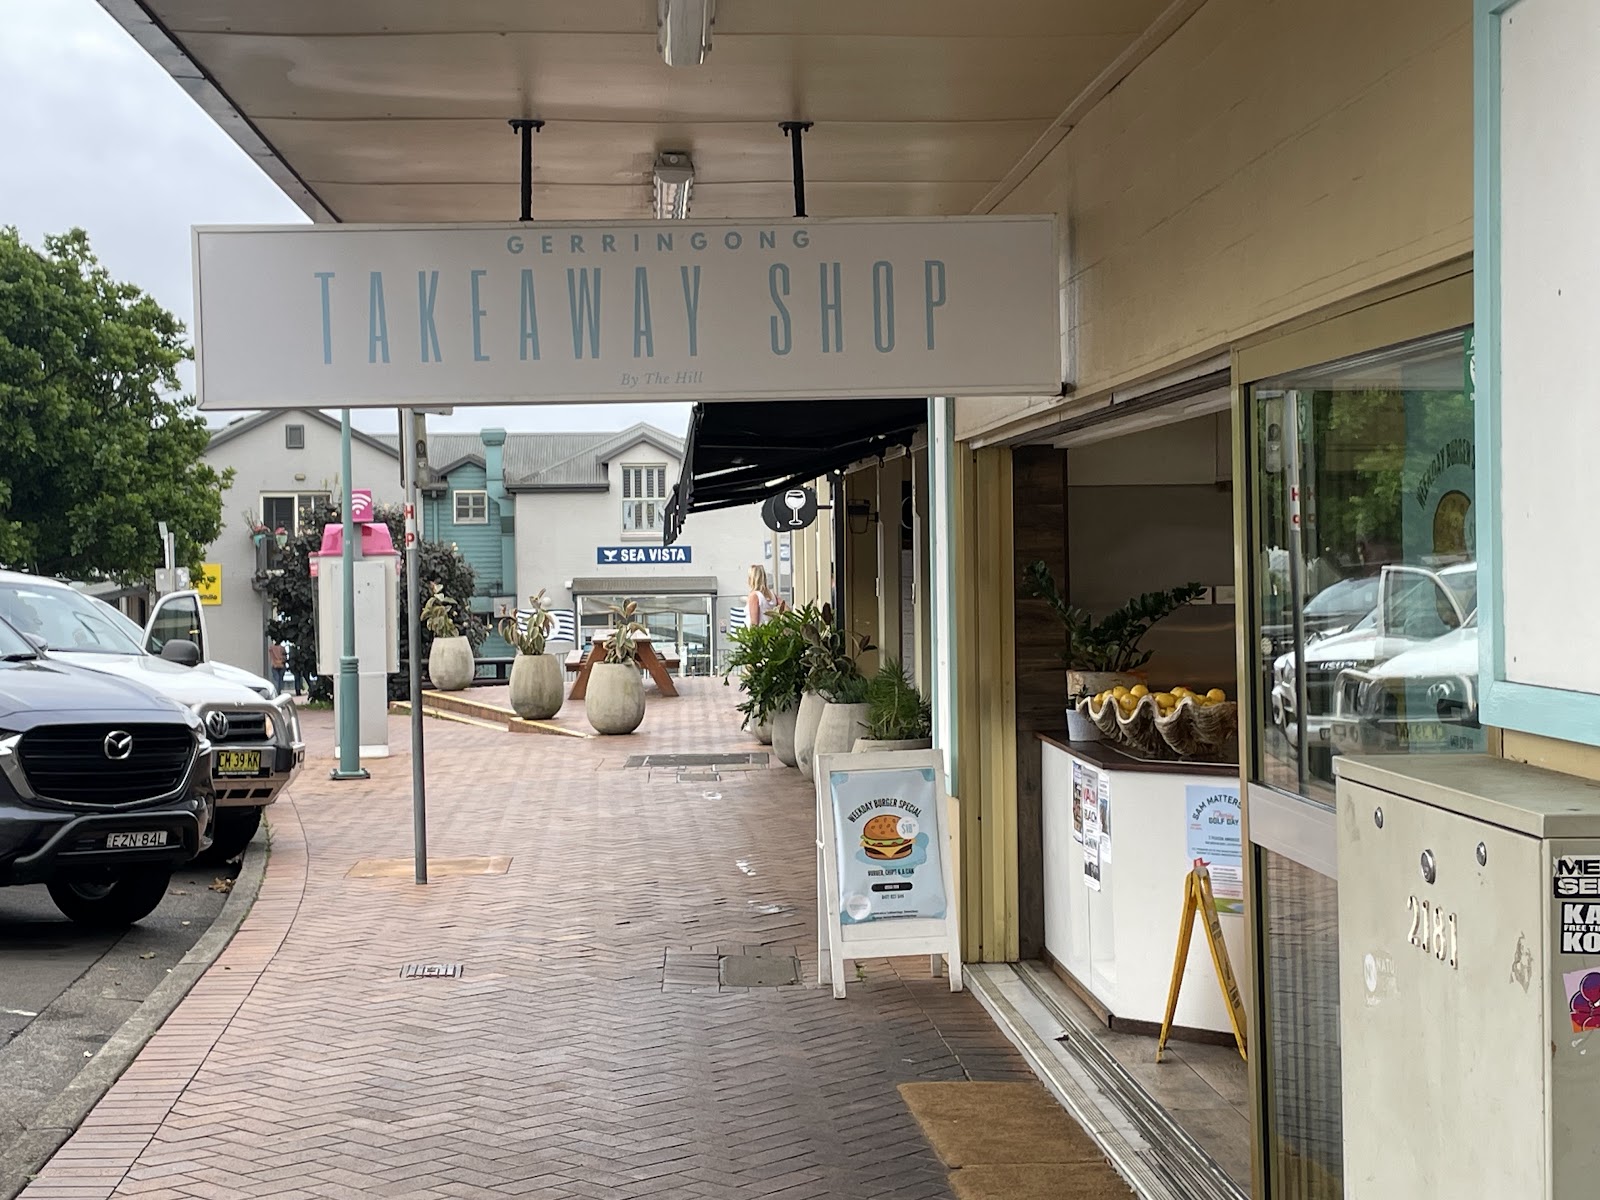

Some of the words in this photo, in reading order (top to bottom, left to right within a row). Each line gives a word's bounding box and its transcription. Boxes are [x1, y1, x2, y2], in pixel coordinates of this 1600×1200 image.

[507, 230, 810, 254] GERRINGONG
[314, 265, 703, 365] TAKEAWAY
[768, 260, 948, 356] SHOP
[620, 373, 639, 388] By
[644, 372, 671, 384] The
[674, 371, 703, 384] Hill
[620, 549, 646, 562] SEA
[649, 548, 686, 561] VISTA
[847, 801, 874, 823] WEEKDAY
[873, 797, 898, 809] BURGER
[898, 799, 922, 818] SPECIAL
[1192, 801, 1207, 820] SAM
[1558, 878, 1600, 895] SE
[1407, 895, 1458, 970] 2181
